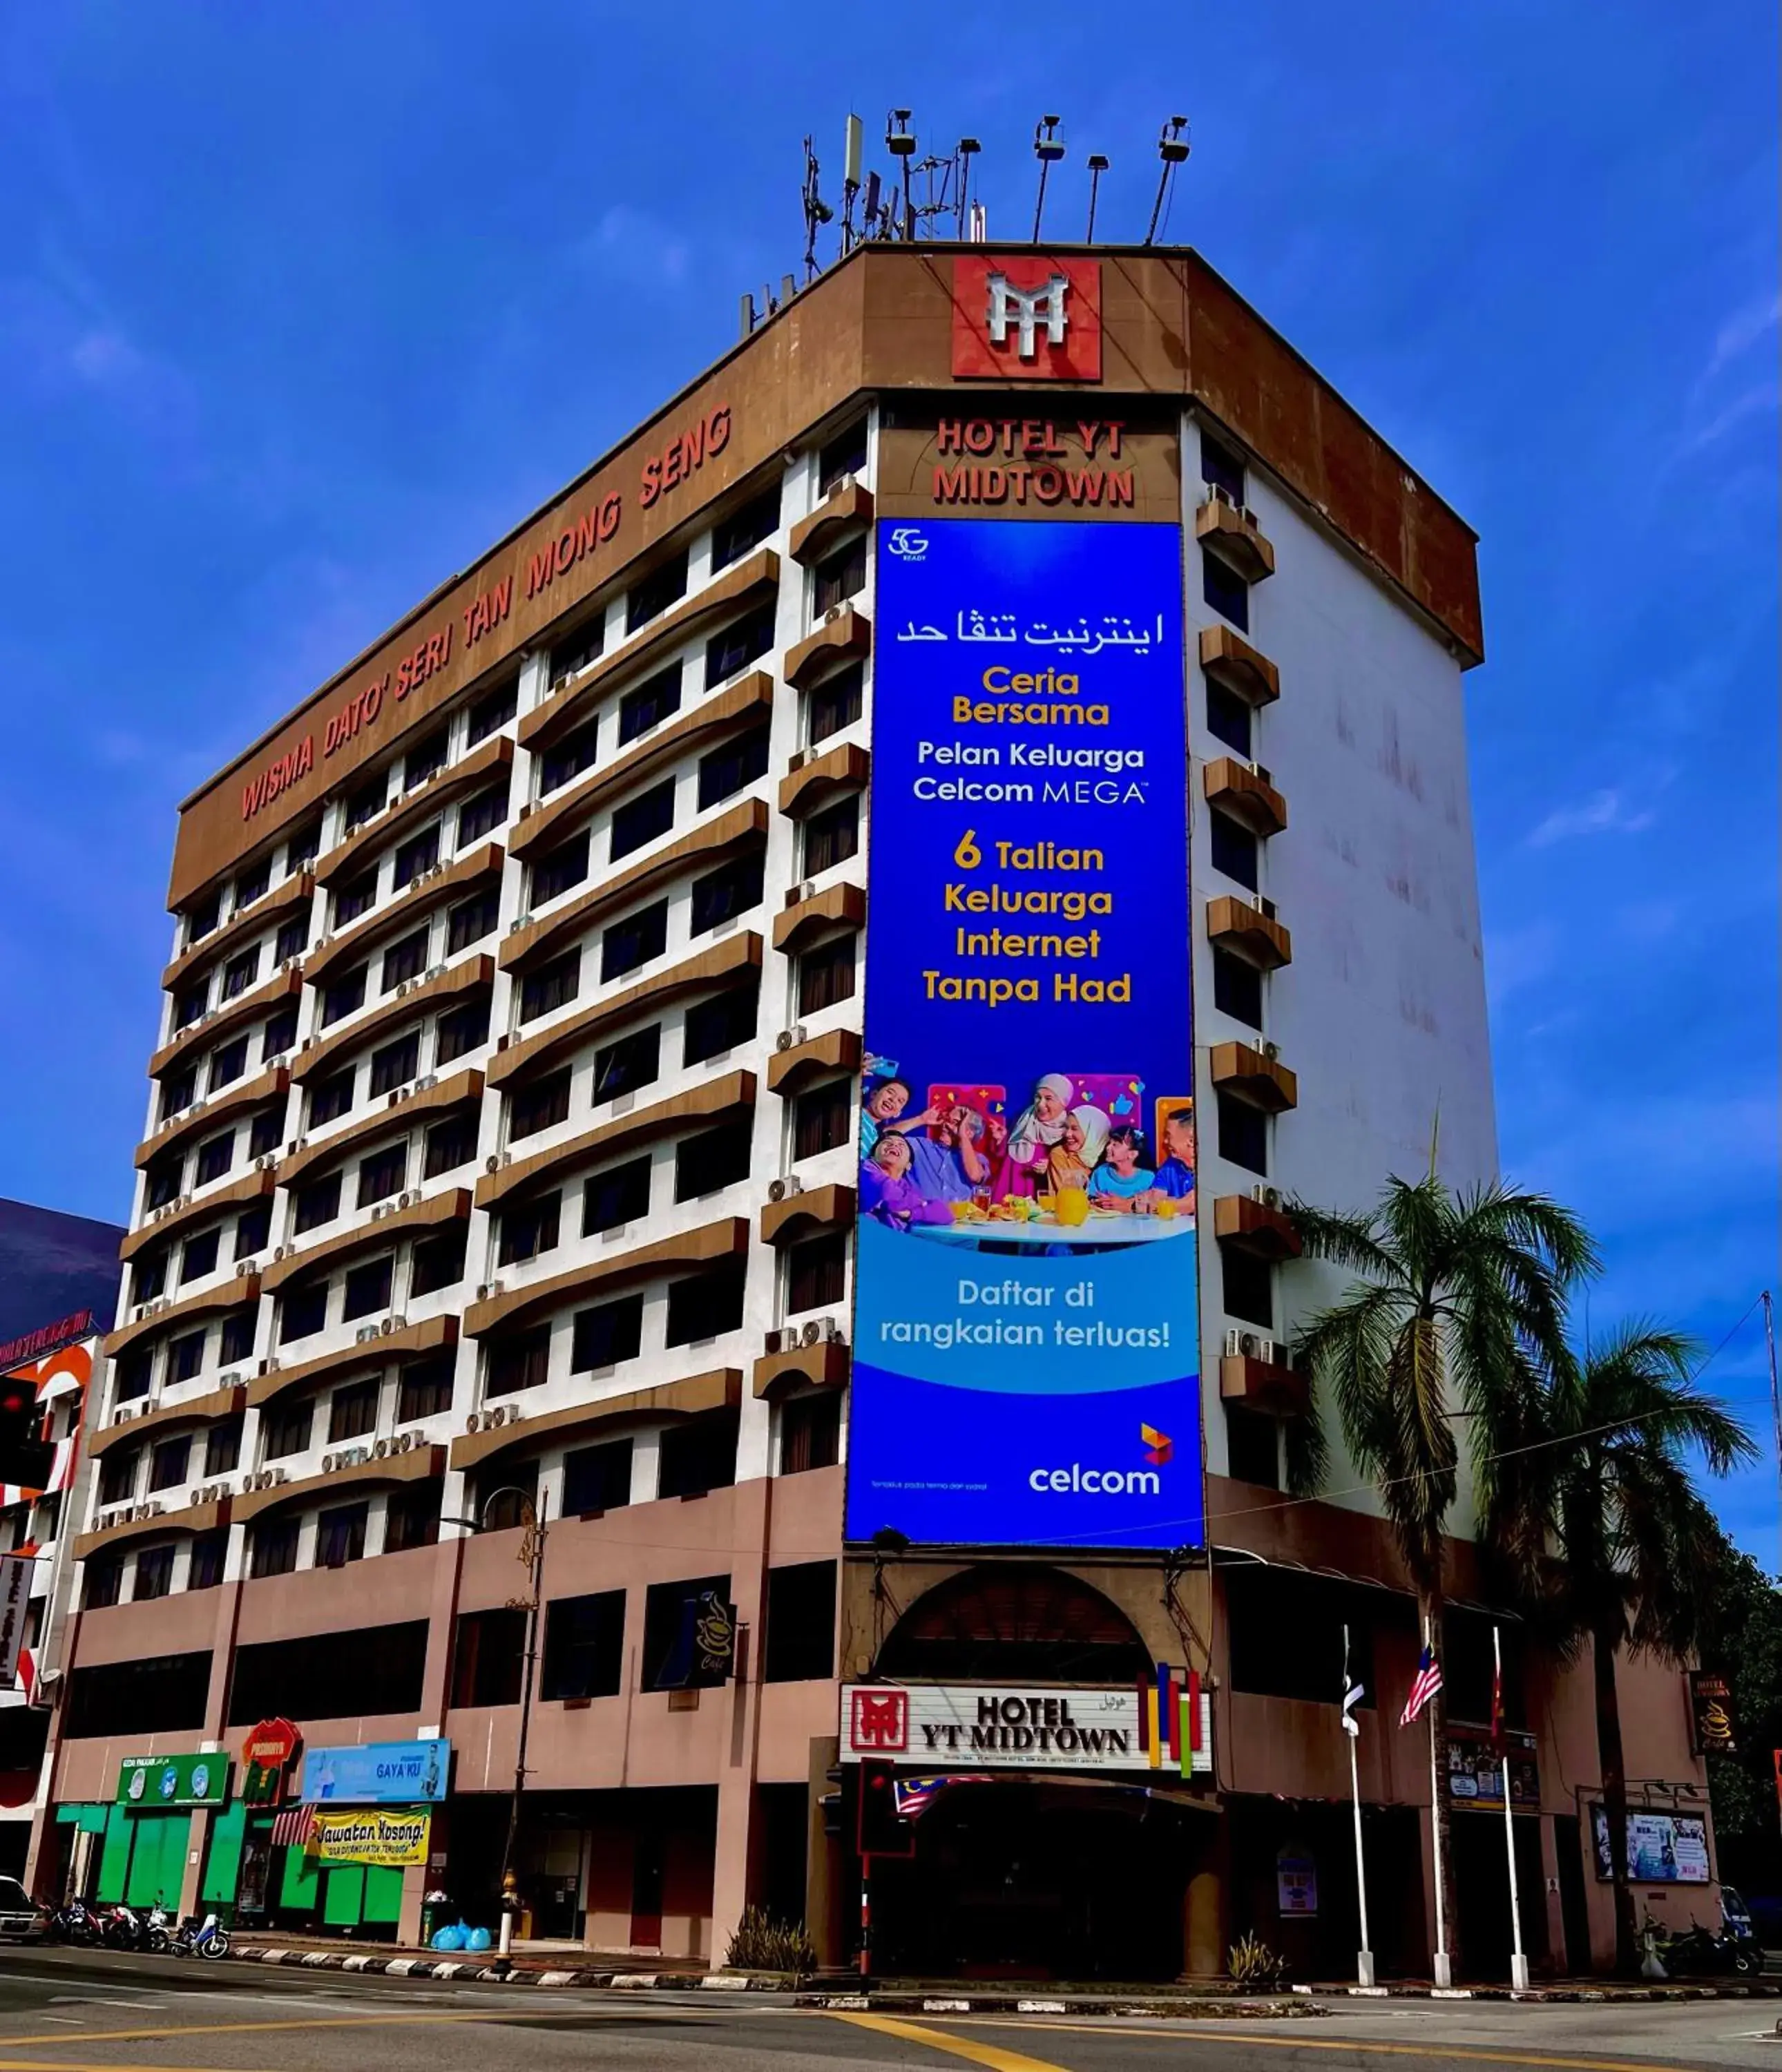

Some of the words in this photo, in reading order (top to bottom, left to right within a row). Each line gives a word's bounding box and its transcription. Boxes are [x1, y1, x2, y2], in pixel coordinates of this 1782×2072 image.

[937, 417, 1066, 456] HOTEL
[1077, 419, 1126, 457] YT
[932, 464, 1134, 506] MIDTOWN
[888, 528, 929, 555] 5G
[242, 735, 314, 822] WISMA
[394, 623, 453, 702] SERI
[463, 575, 513, 649] TAN
[526, 490, 622, 600] MONG
[639, 402, 731, 510] SENG
[897, 622, 948, 642] حد
[982, 666, 1080, 695] Ceria
[952, 696, 1110, 725] Bersama
[918, 741, 1000, 766] Pelan
[1010, 743, 1144, 774] Keluarga
[913, 777, 1034, 802] Celcom
[954, 829, 981, 869] 6
[995, 841, 1104, 871] Talian
[944, 883, 1112, 921] Keluarga
[956, 927, 1102, 958] Internet
[923, 970, 1039, 1008] Tanpa
[1054, 973, 1131, 1002] Had
[958, 1279, 1055, 1307] Daftar
[1064, 1281, 1094, 1307] di
[881, 1318, 1044, 1350] rangkaian
[1053, 1321, 1170, 1348] terluas!
[1028, 1463, 1160, 1495] celcom
[977, 1696, 1074, 1725] HOTEL
[921, 1724, 963, 1749] YT
[970, 1726, 1130, 1753] MIDTOWN
[317, 1823, 375, 1844] Jawatan
[378, 1816, 426, 1848] Kosong!
